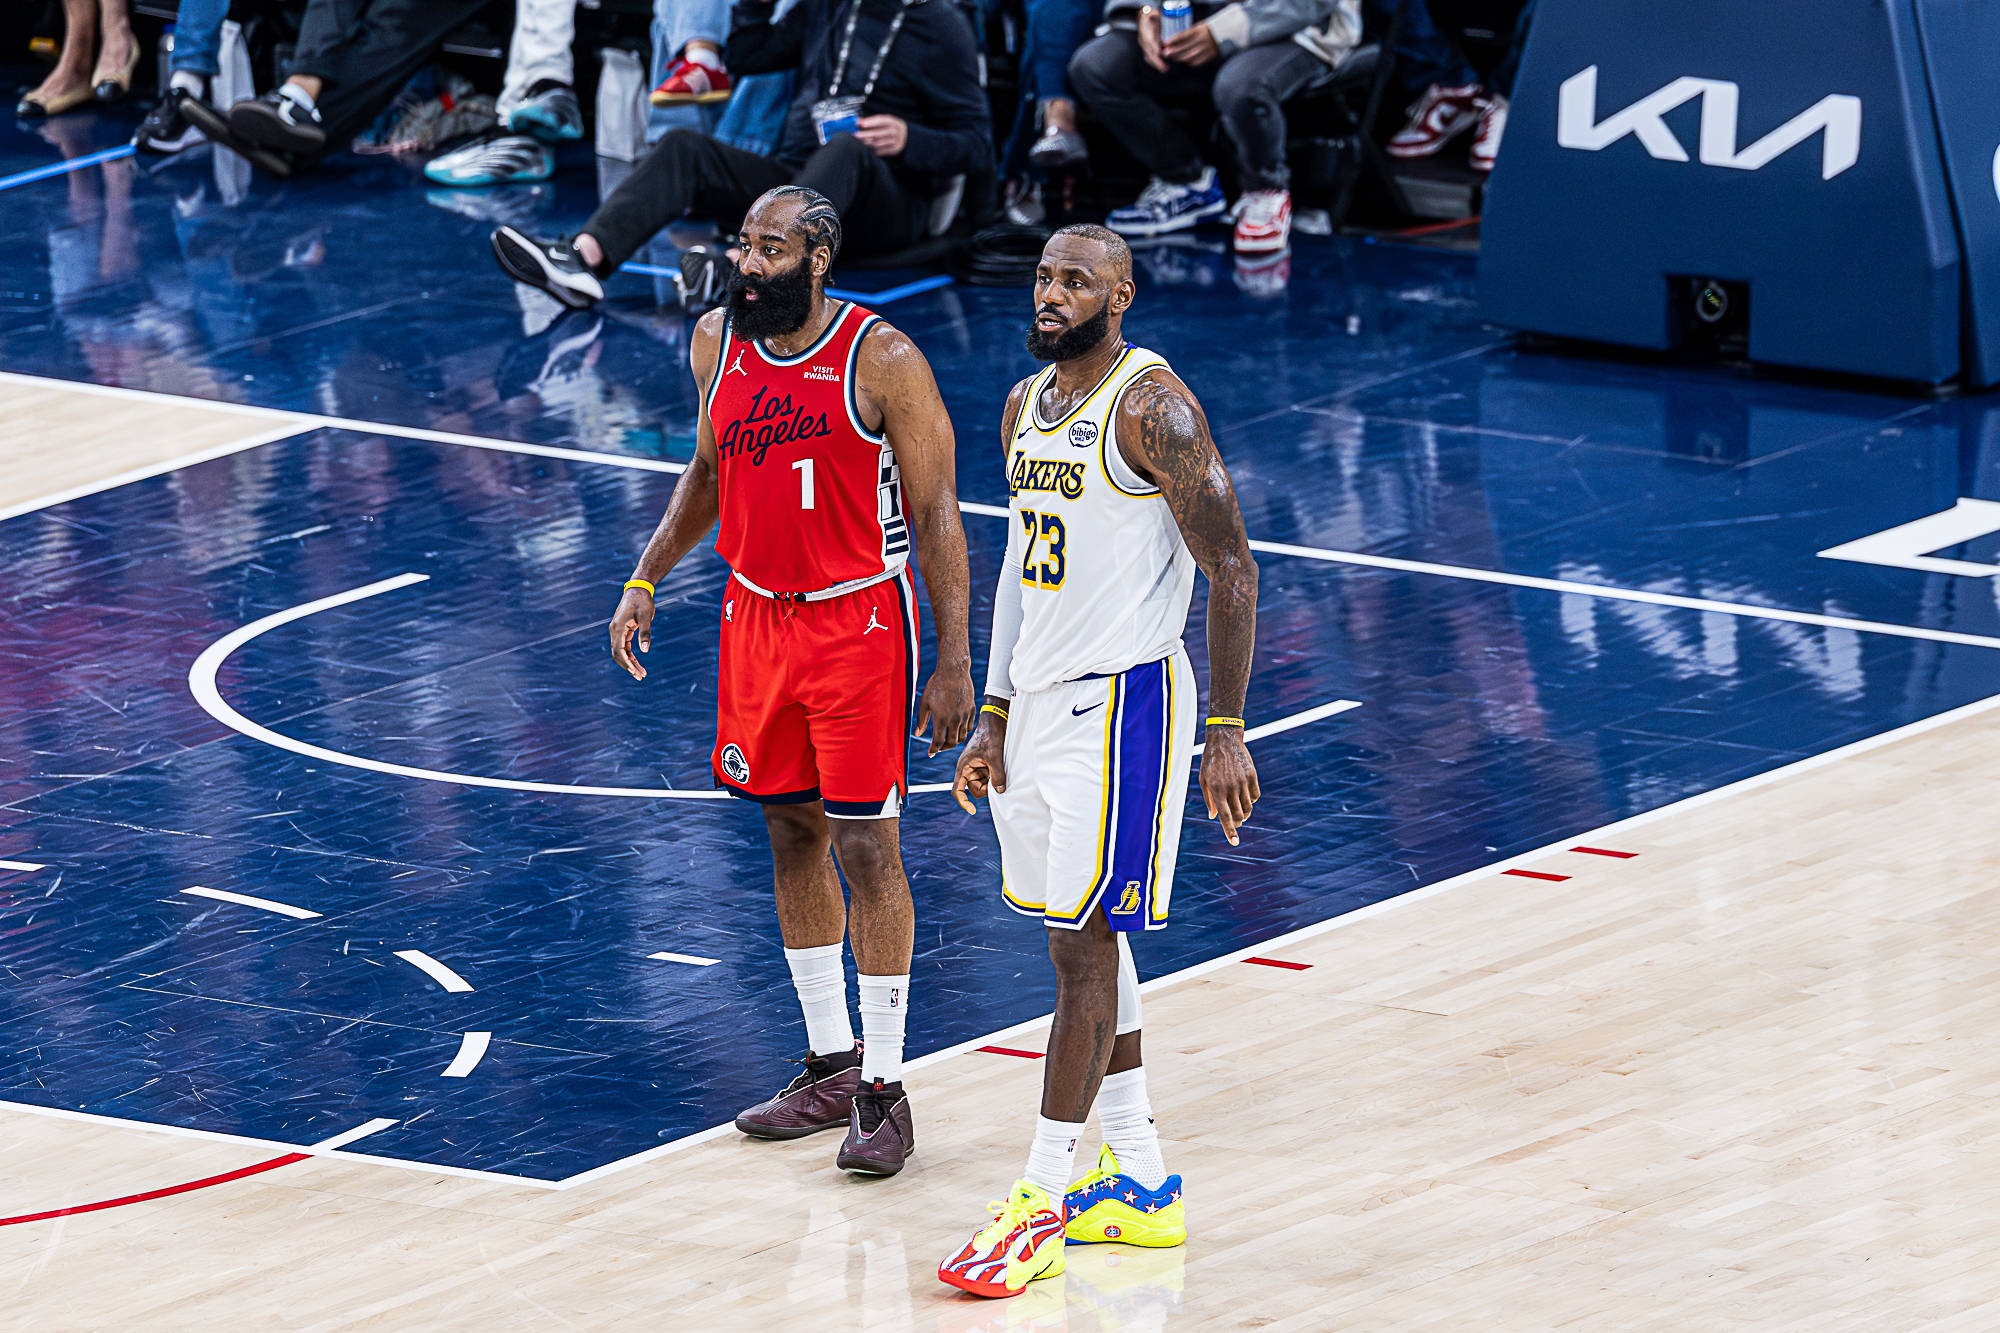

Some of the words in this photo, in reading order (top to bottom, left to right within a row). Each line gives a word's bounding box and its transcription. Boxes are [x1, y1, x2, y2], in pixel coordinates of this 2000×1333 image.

[1557, 64, 1862, 181] KIA
[803, 371, 840, 382] RWANDA
[812, 365, 834, 375] VISIT
[744, 384, 795, 425] Los
[719, 405, 832, 467] Angeles
[1071, 426, 1096, 441] bibigo
[791, 457, 815, 510] 1
[1010, 449, 1087, 501] LAKERS
[1020, 508, 1067, 592] 23
